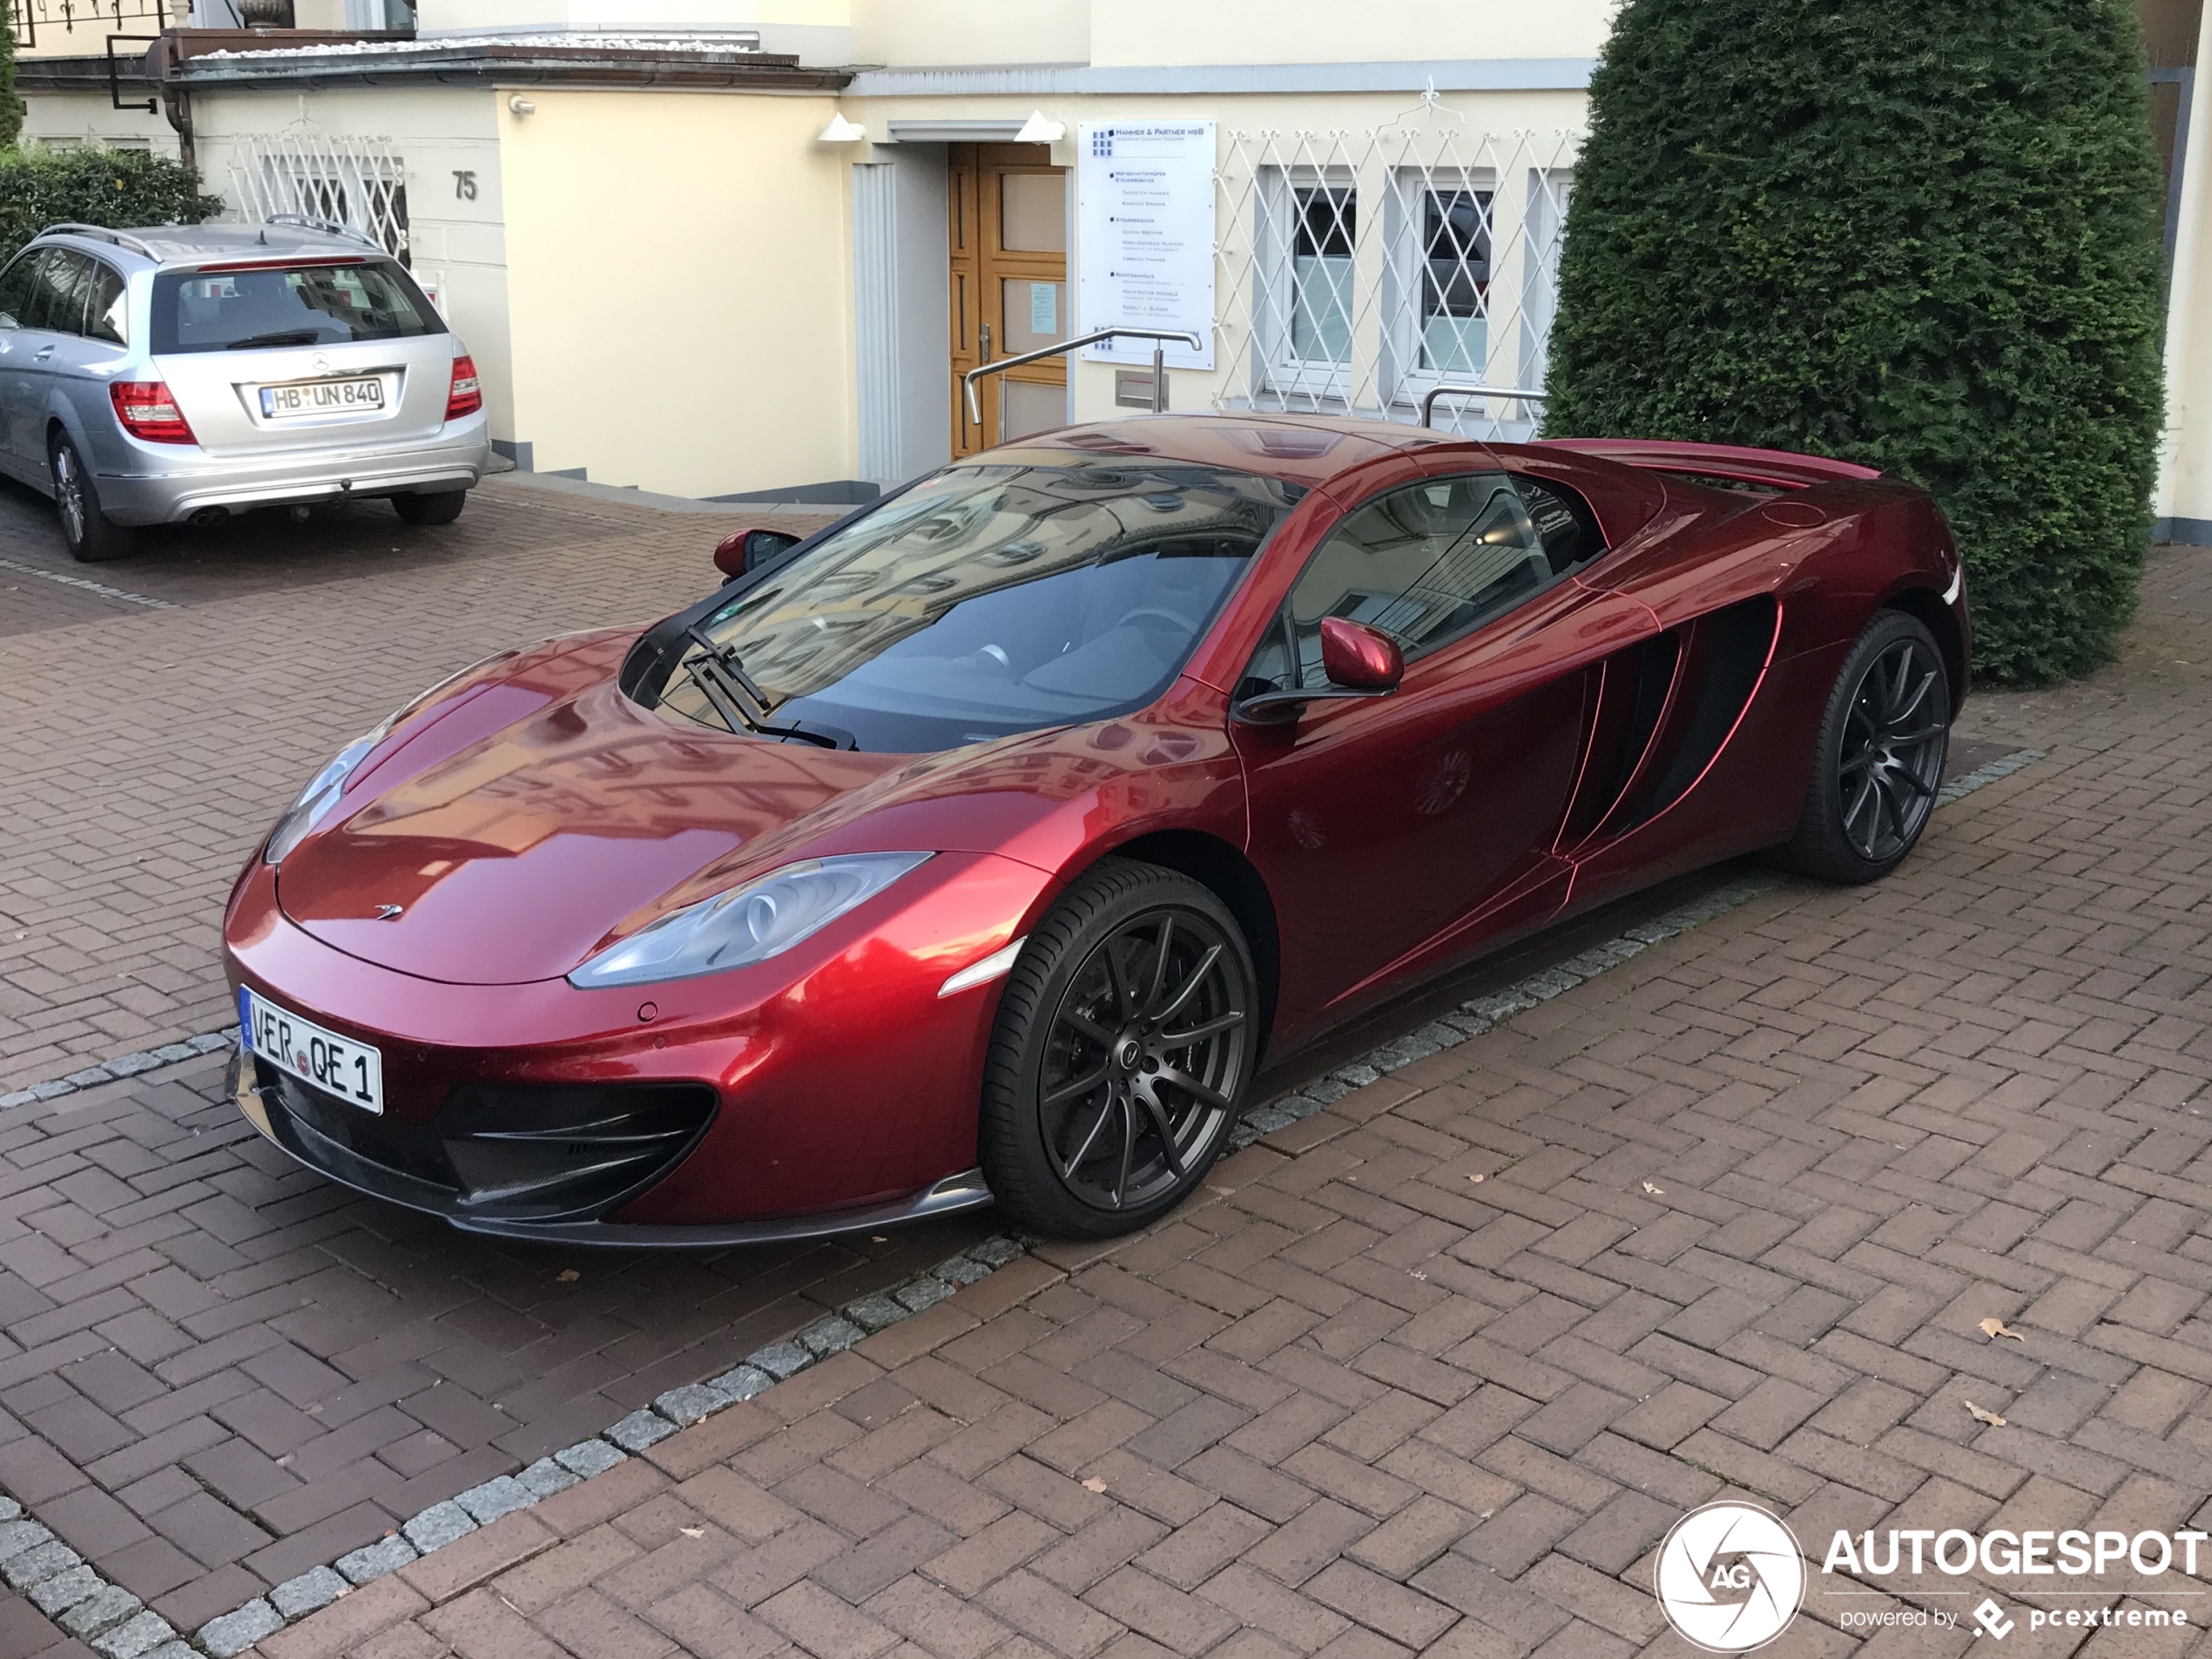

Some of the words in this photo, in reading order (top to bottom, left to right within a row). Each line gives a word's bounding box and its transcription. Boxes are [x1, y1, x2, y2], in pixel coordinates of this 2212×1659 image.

[452, 170, 477, 200] 75
[274, 389, 301, 409] HB
[313, 386, 341, 406] UN
[343, 383, 380, 403] 840
[252, 1002, 296, 1069] VER
[311, 1036, 348, 1093] QE
[354, 1055, 374, 1103] 1
